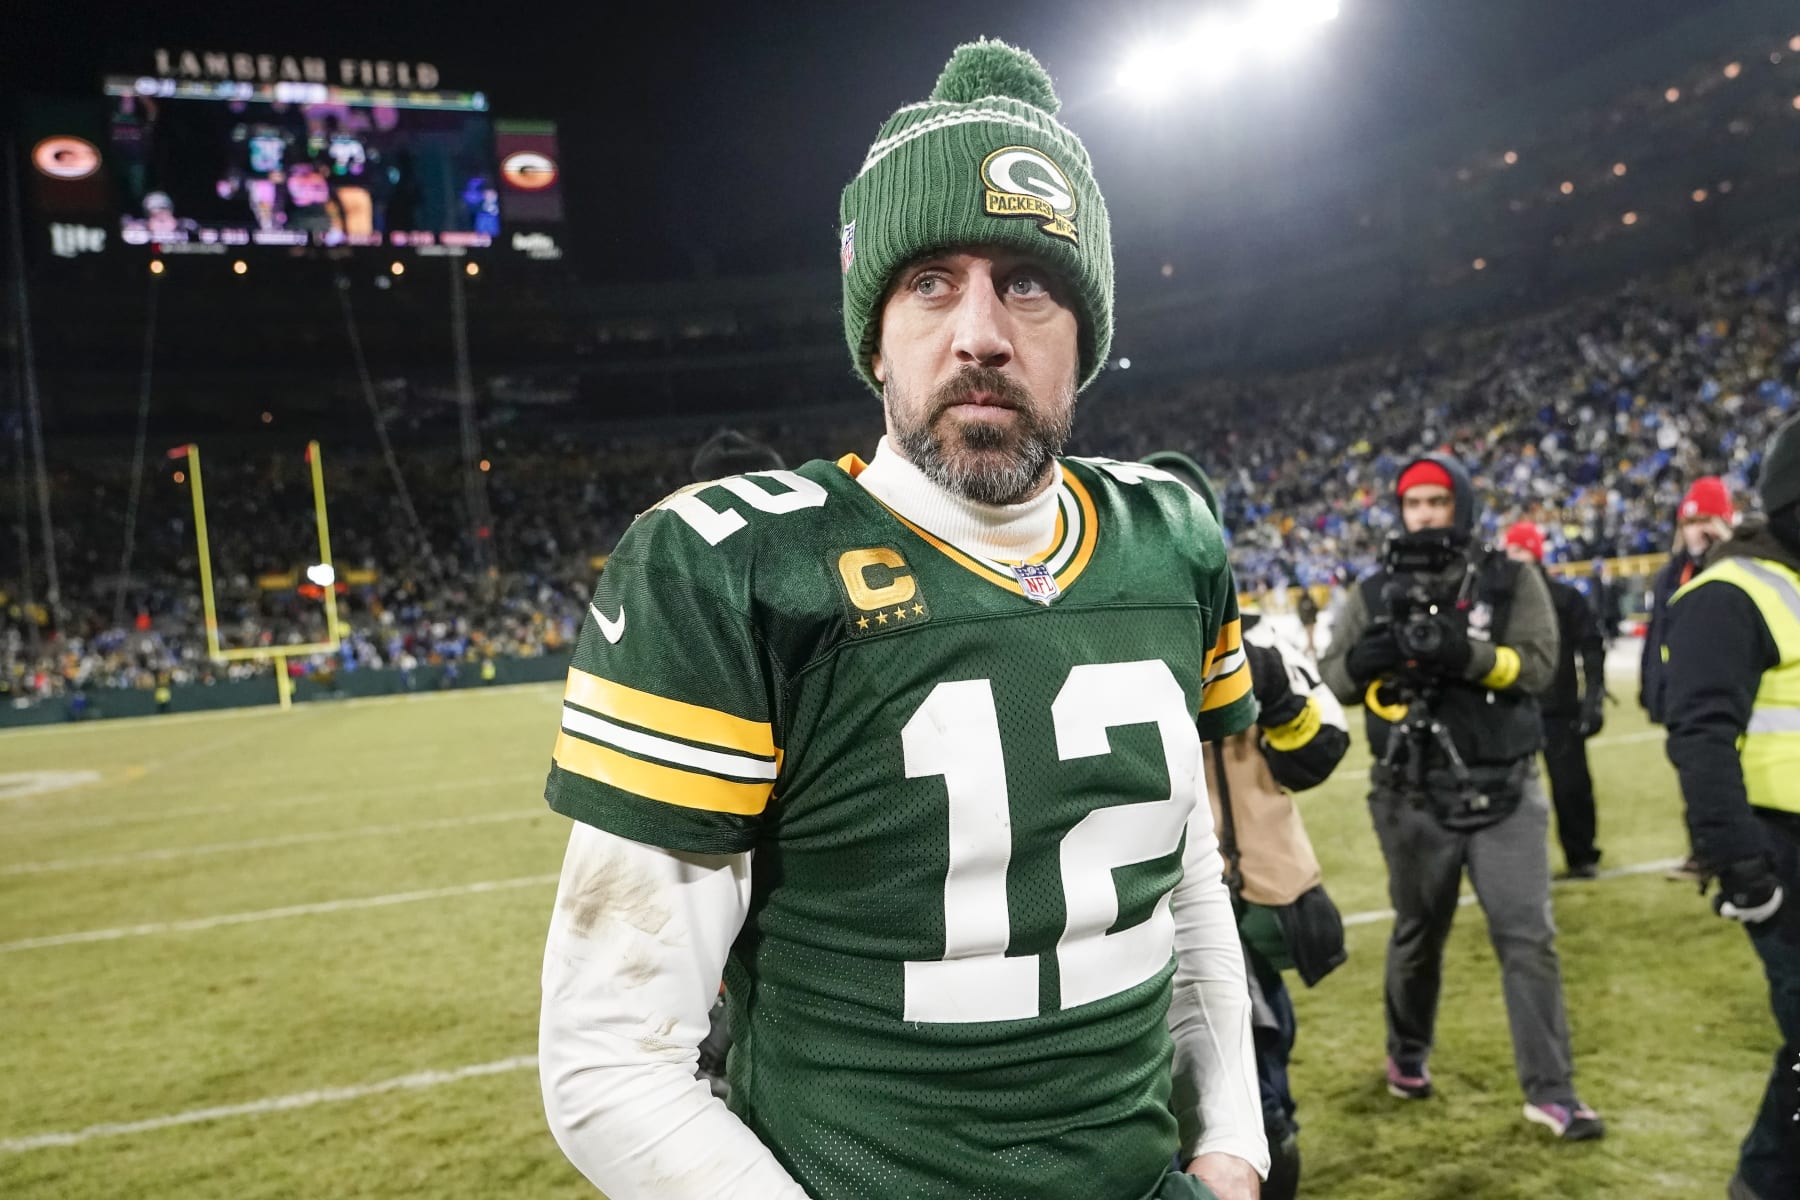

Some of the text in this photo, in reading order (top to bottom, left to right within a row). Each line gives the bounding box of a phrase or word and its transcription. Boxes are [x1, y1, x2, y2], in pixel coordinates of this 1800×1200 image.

[338, 59, 440, 89] FIELD
[989, 194, 1051, 215] PACKERS
[838, 547, 916, 611] C
[1024, 576, 1054, 594] NFL
[901, 659, 1200, 1022] 12
